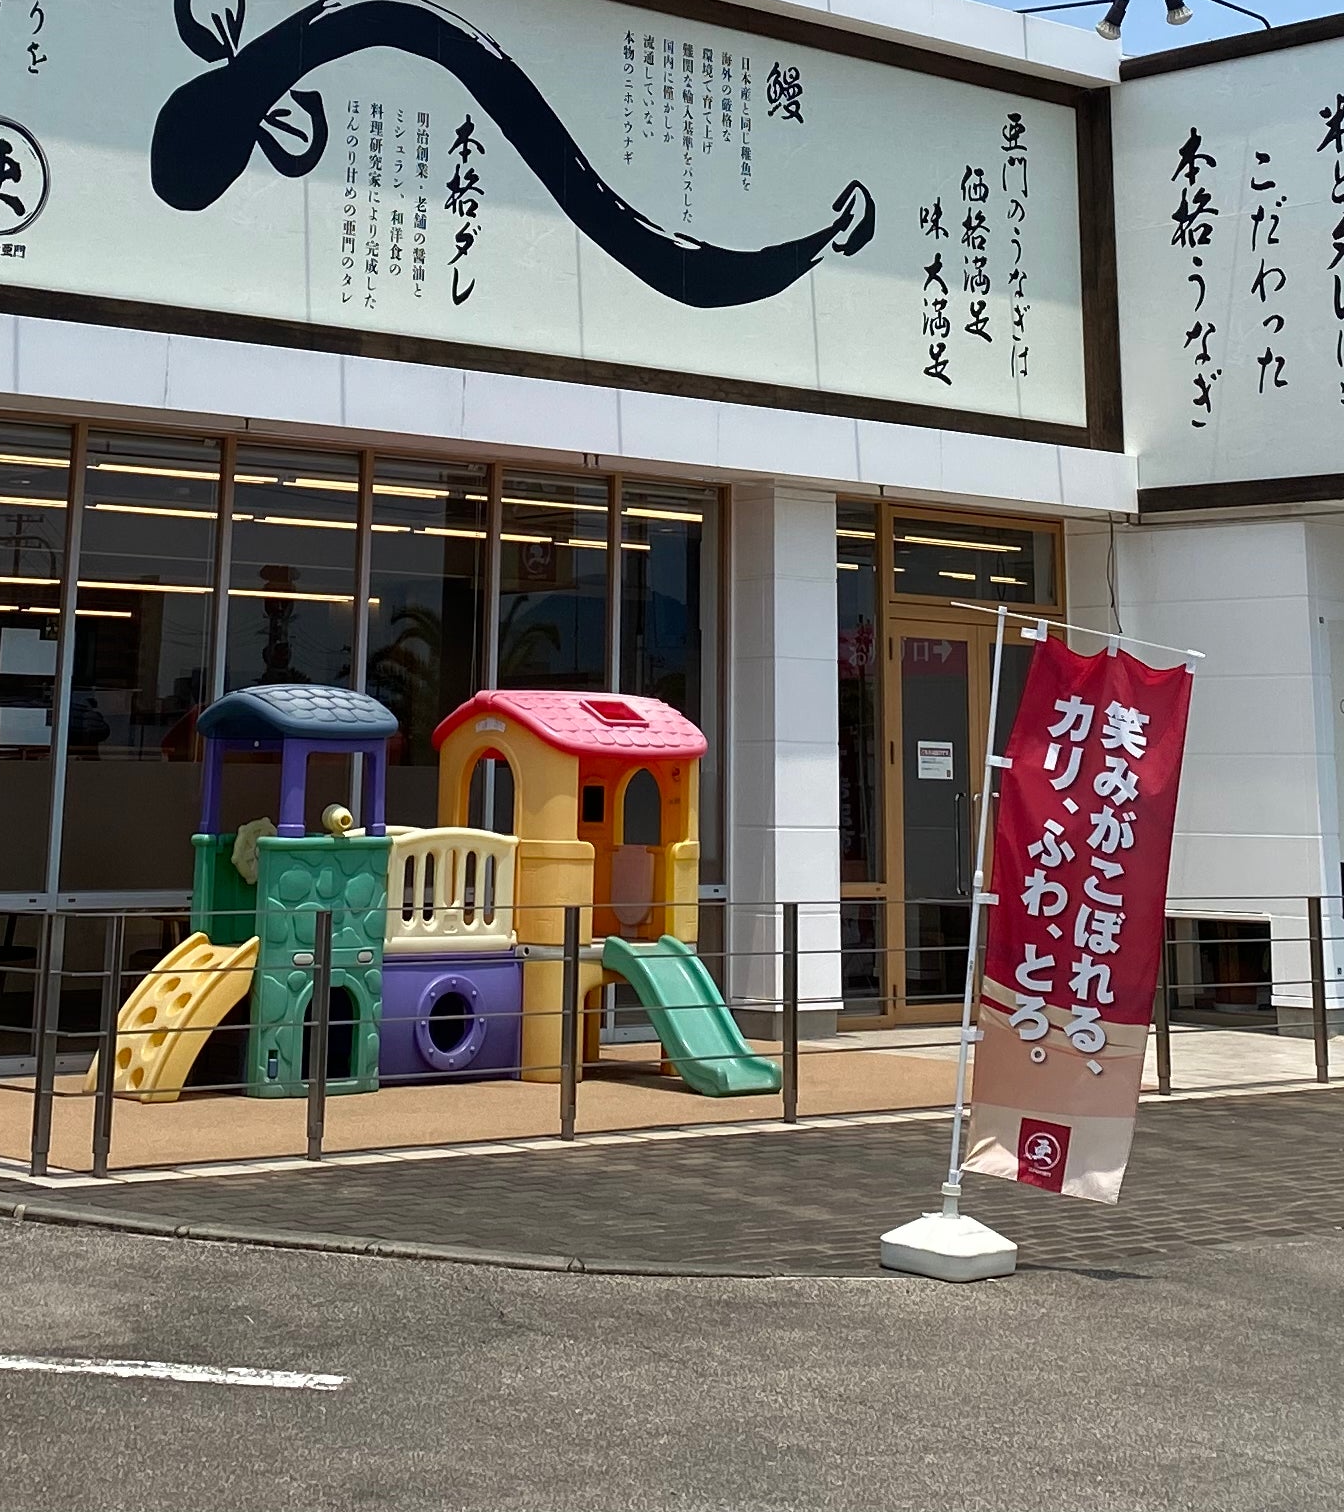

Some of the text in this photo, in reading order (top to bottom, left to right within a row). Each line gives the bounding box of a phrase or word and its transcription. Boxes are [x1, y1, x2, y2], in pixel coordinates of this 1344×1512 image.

[389, 108, 407, 276] ミシュラン、和洋食の
[766, 61, 805, 124] 鰻
[341, 100, 360, 303] ほんのり甘めの亜門のタレ
[364, 102, 384, 310] 料理研究家により完成した
[443, 113, 486, 306] 本格ダレ
[960, 164, 993, 343] 価格満足
[1000, 111, 1032, 378] 亜門のうなぎは
[1170, 126, 1224, 428] 本格うなぎ
[1250, 151, 1288, 395] こだわった
[1008, 694, 1096, 1065] カリ、ふわ、とろ。
[1063, 698, 1151, 1077] 笑みがこぼれる、
